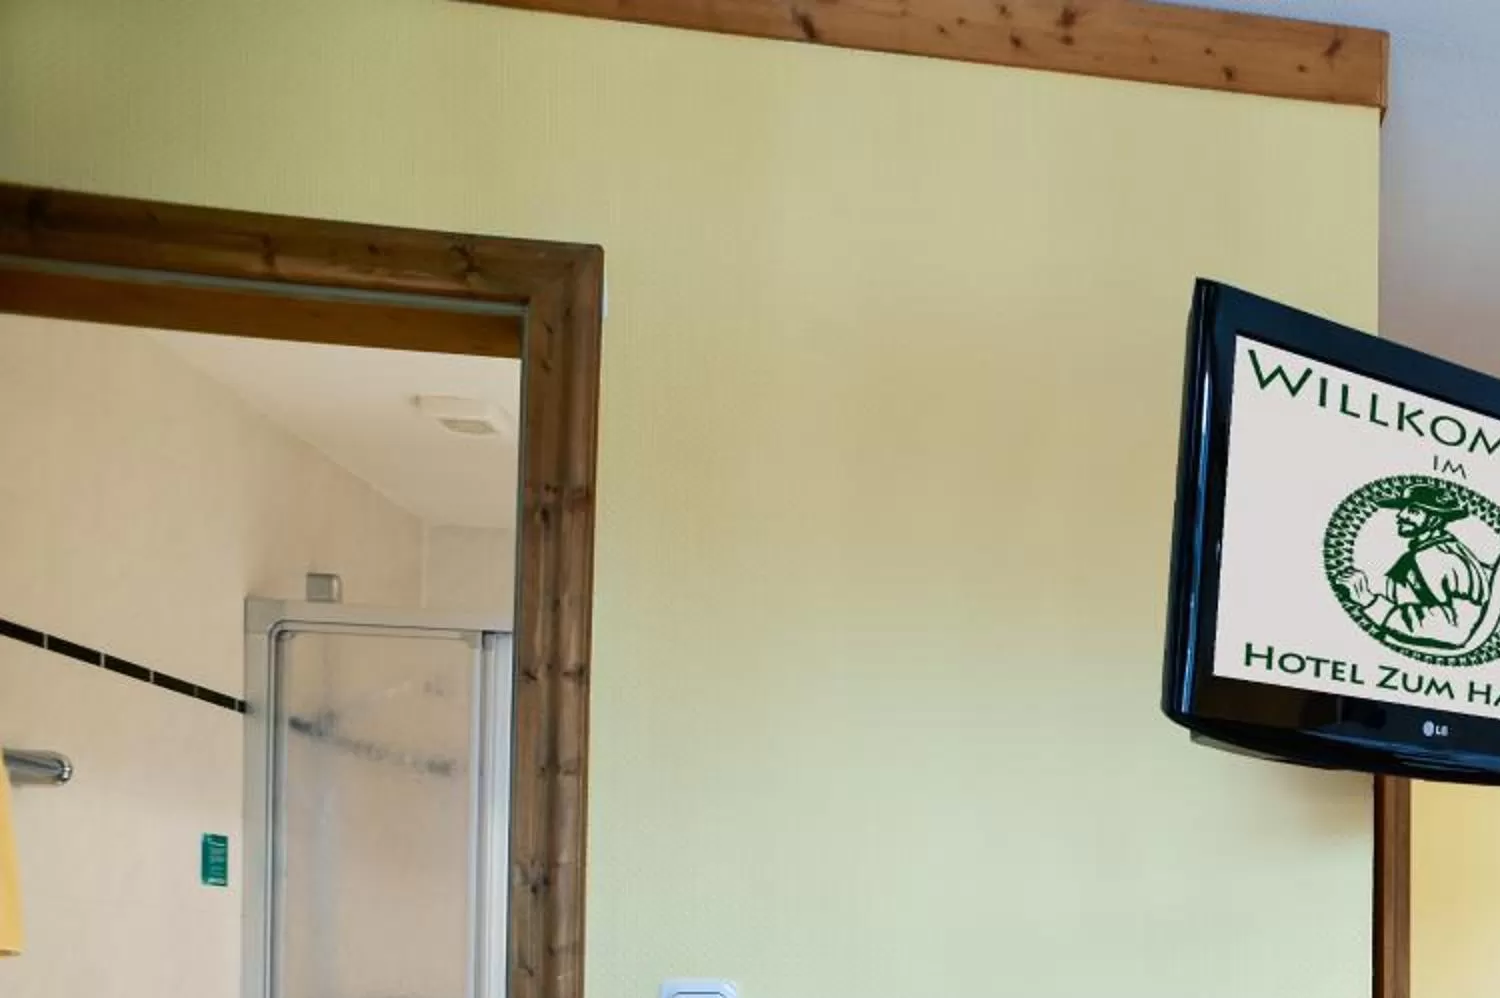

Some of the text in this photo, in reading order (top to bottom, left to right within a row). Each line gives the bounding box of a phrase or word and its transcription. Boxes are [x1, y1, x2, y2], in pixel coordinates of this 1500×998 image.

[1434, 455, 1467, 479] IM
[1244, 642, 1365, 685] HOTEL
[1376, 665, 1455, 700] ZUM
